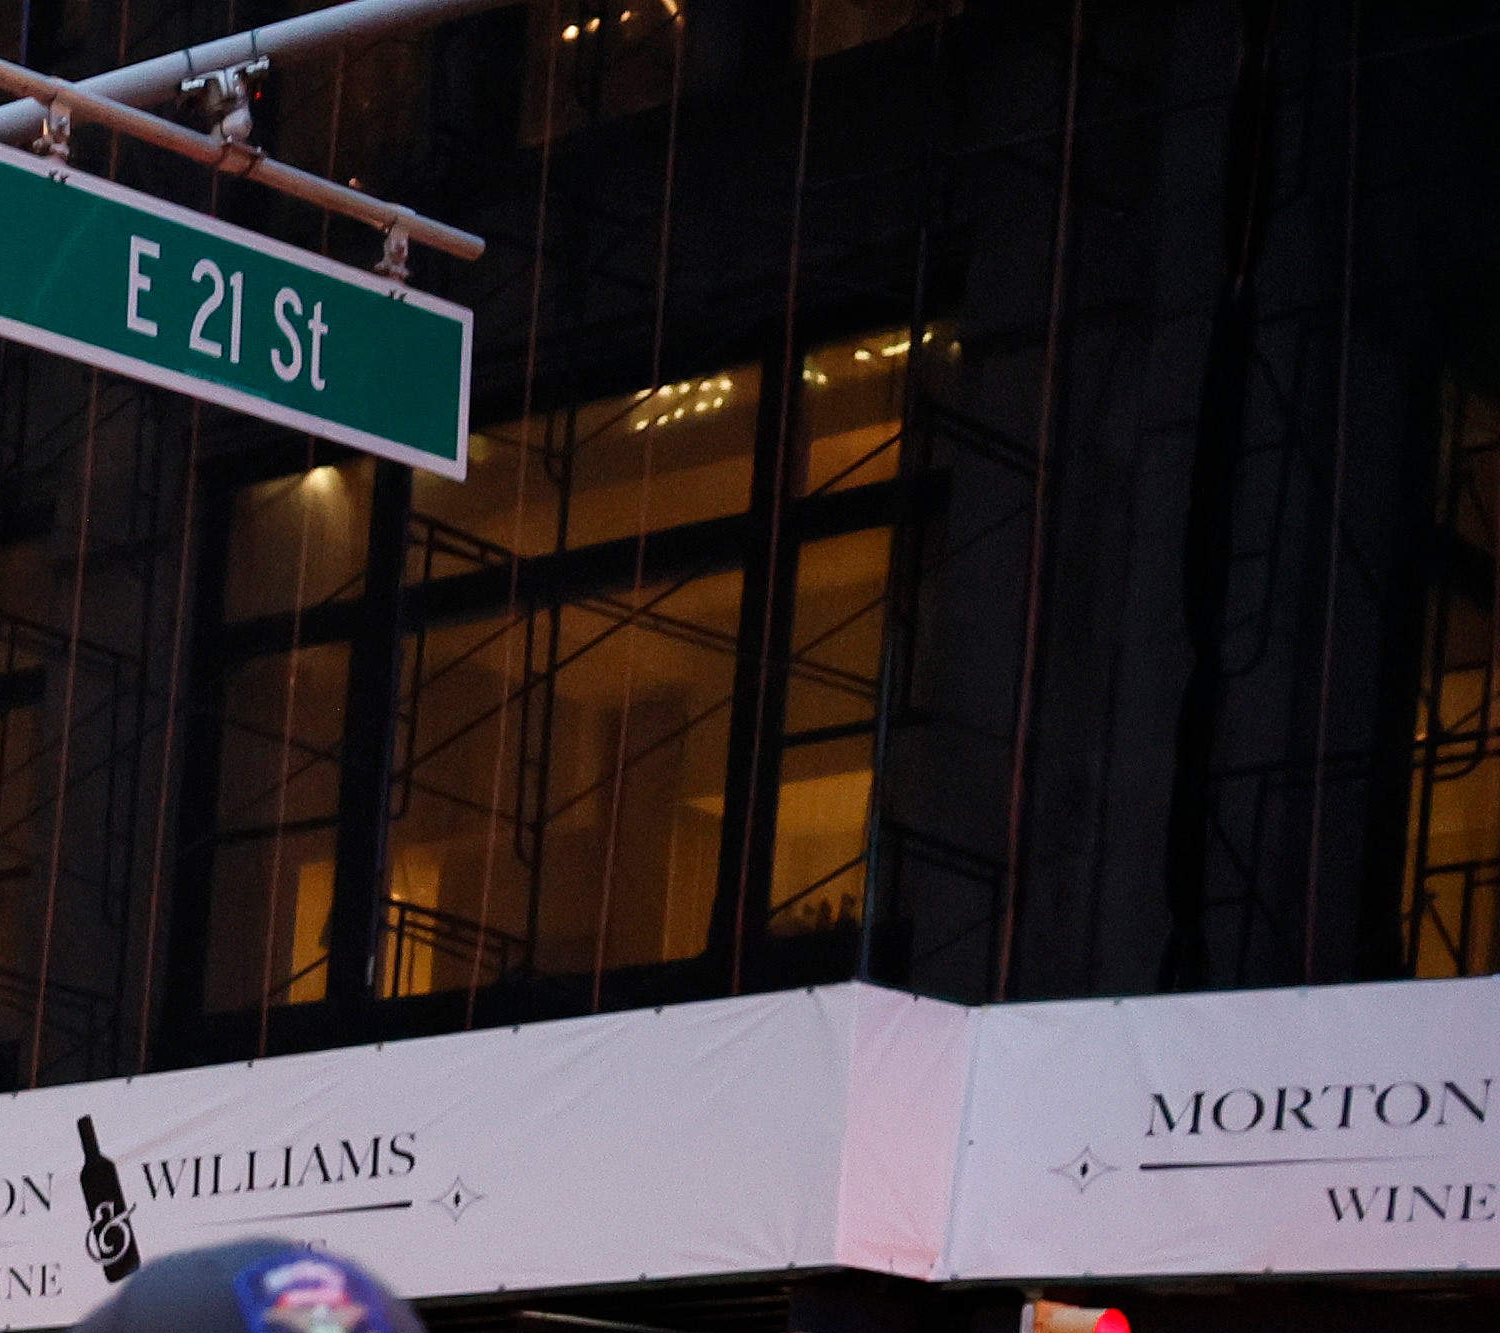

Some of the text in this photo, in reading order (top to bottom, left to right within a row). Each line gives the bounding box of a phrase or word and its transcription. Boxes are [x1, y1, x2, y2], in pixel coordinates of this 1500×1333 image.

[127, 235, 329, 391] E 21 St
[1146, 1078, 1493, 1136] MORTON
[141, 1131, 417, 1201] WILLIAMS
[1327, 1182, 1497, 1223] WINE
